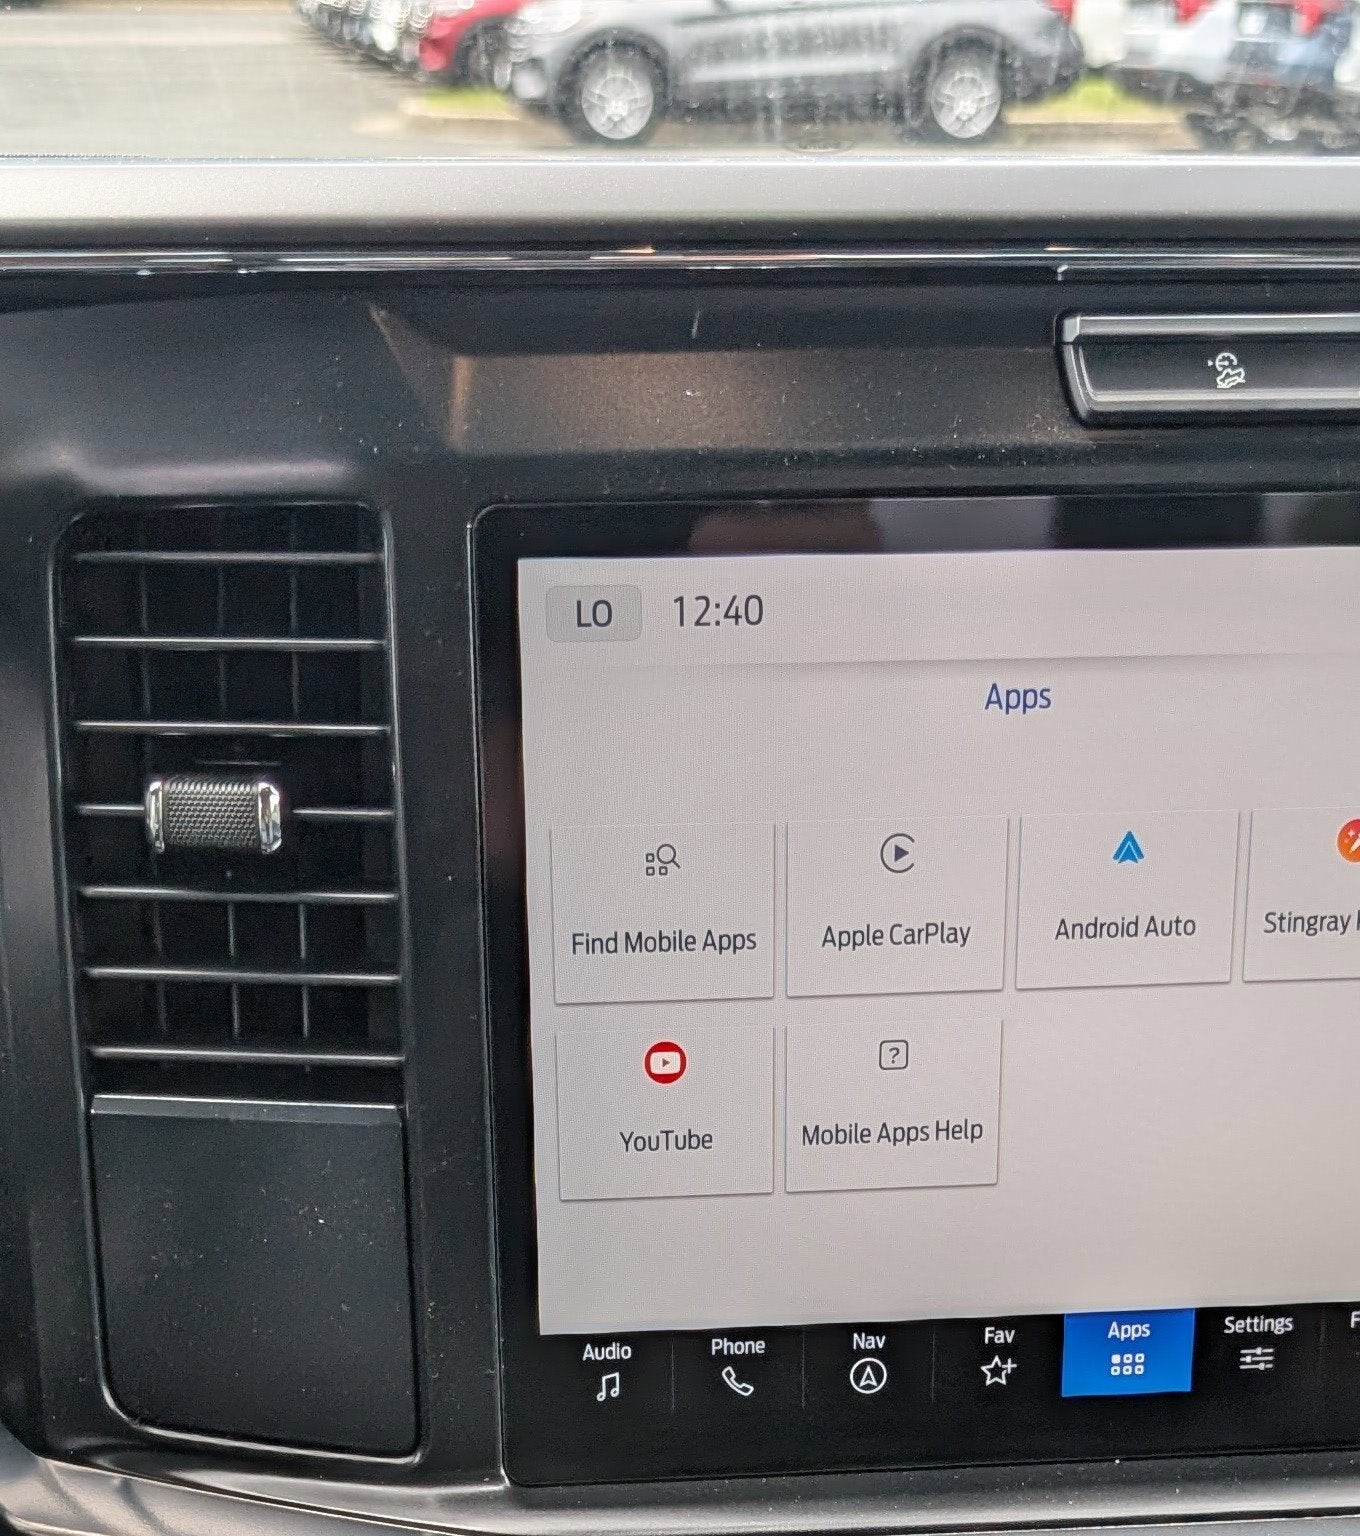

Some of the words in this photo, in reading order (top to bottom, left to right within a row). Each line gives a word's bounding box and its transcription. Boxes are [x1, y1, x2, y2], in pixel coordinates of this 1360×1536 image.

[577, 600, 612, 627] LO
[674, 595, 763, 626] 12:40
[985, 683, 1051, 714] Apps
[1055, 916, 1139, 939] Android
[1145, 916, 1196, 937] Auto
[1264, 912, 1351, 936] Stingray
[572, 931, 617, 954] Find
[625, 930, 696, 953] Mobile
[702, 930, 756, 955] Apps
[822, 924, 883, 951] Apple
[890, 922, 970, 947] CarPlay
[620, 1129, 712, 1152] YouTube
[803, 1123, 871, 1145] Mobile
[877, 1123, 929, 1146] Apps
[936, 1119, 983, 1143] Help
[985, 1327, 1015, 1344] Fav
[1108, 1322, 1150, 1341] Apps
[1224, 1316, 1293, 1334] Settings
[583, 1343, 631, 1360] Audio
[712, 1338, 765, 1355] Phone
[853, 1333, 885, 1349] Nav
